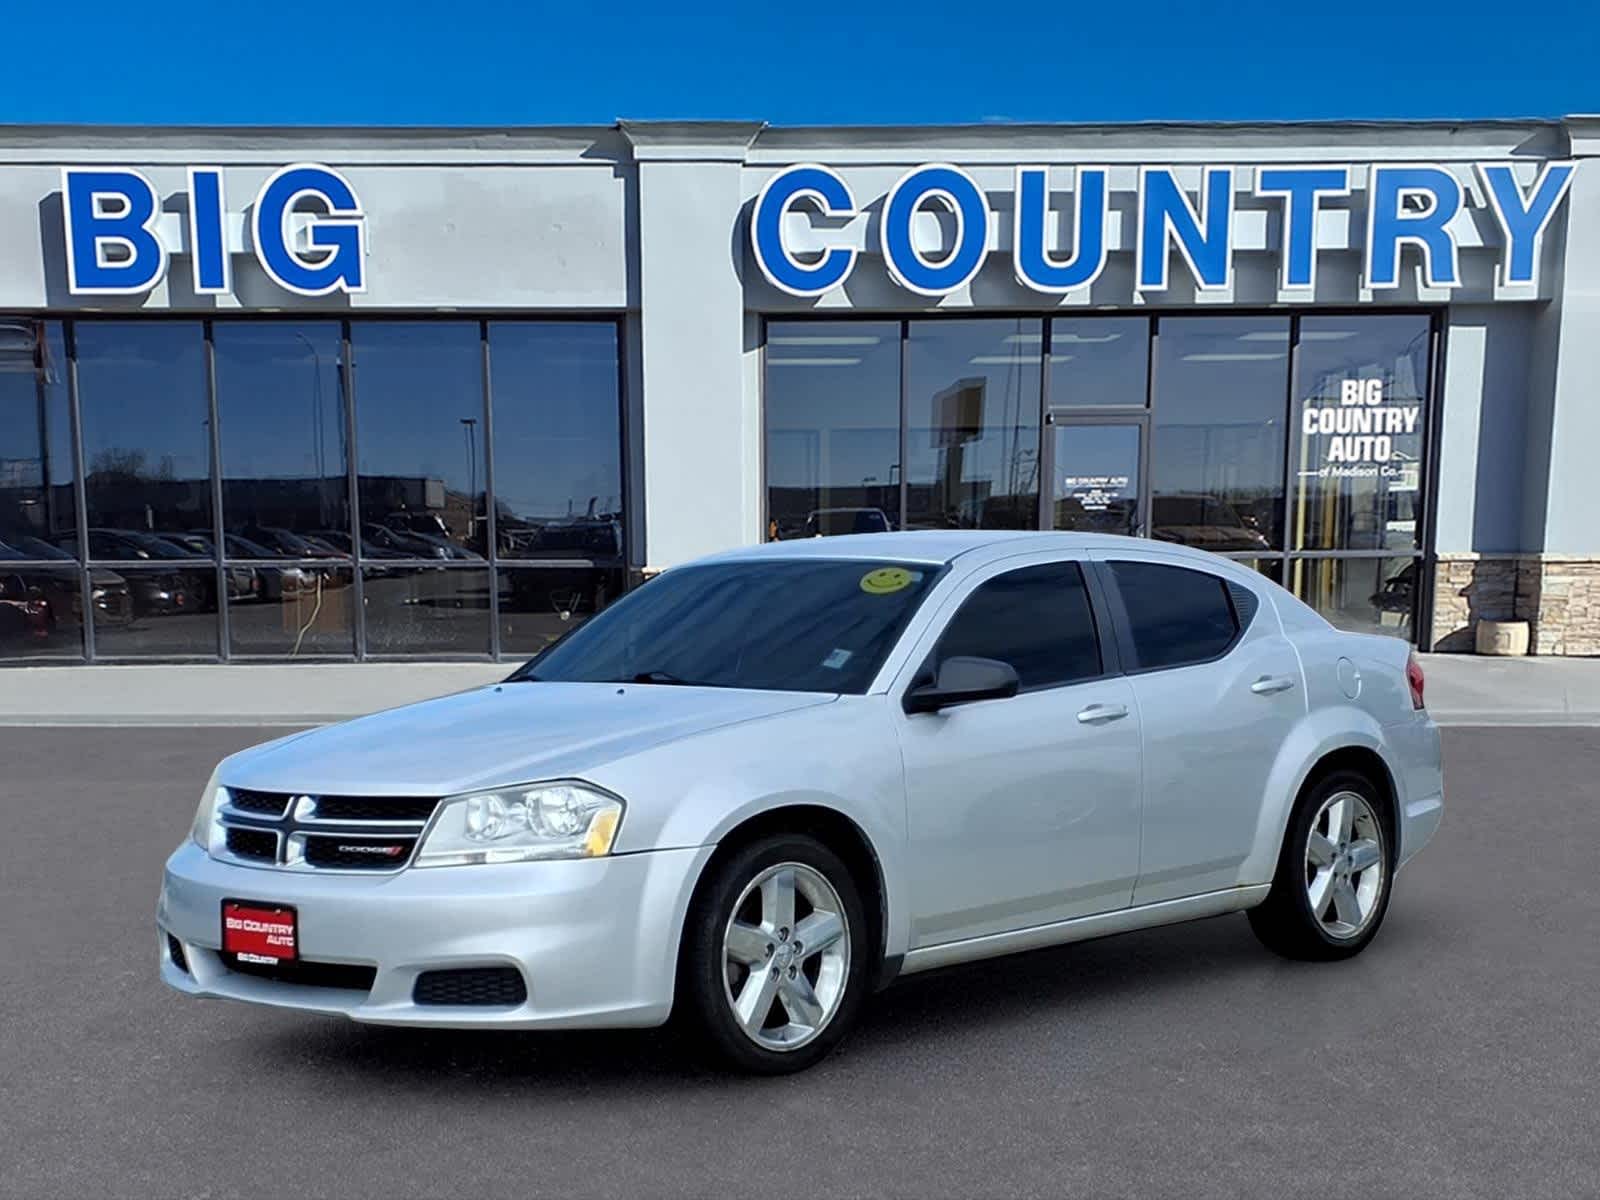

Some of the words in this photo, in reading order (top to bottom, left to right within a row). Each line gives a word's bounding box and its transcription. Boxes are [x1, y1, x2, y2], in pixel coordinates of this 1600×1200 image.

[61, 162, 368, 296] BIG
[751, 160, 1579, 297] COUNTRY
[1341, 378, 1383, 406] BIG
[1302, 407, 1420, 434] COUNTRY
[1327, 435, 1392, 462] AUTO
[1319, 465, 1331, 478] of
[338, 844, 390, 854] DODGE
[243, 919, 294, 936] COUNTRY
[266, 934, 295, 948] AUTO
